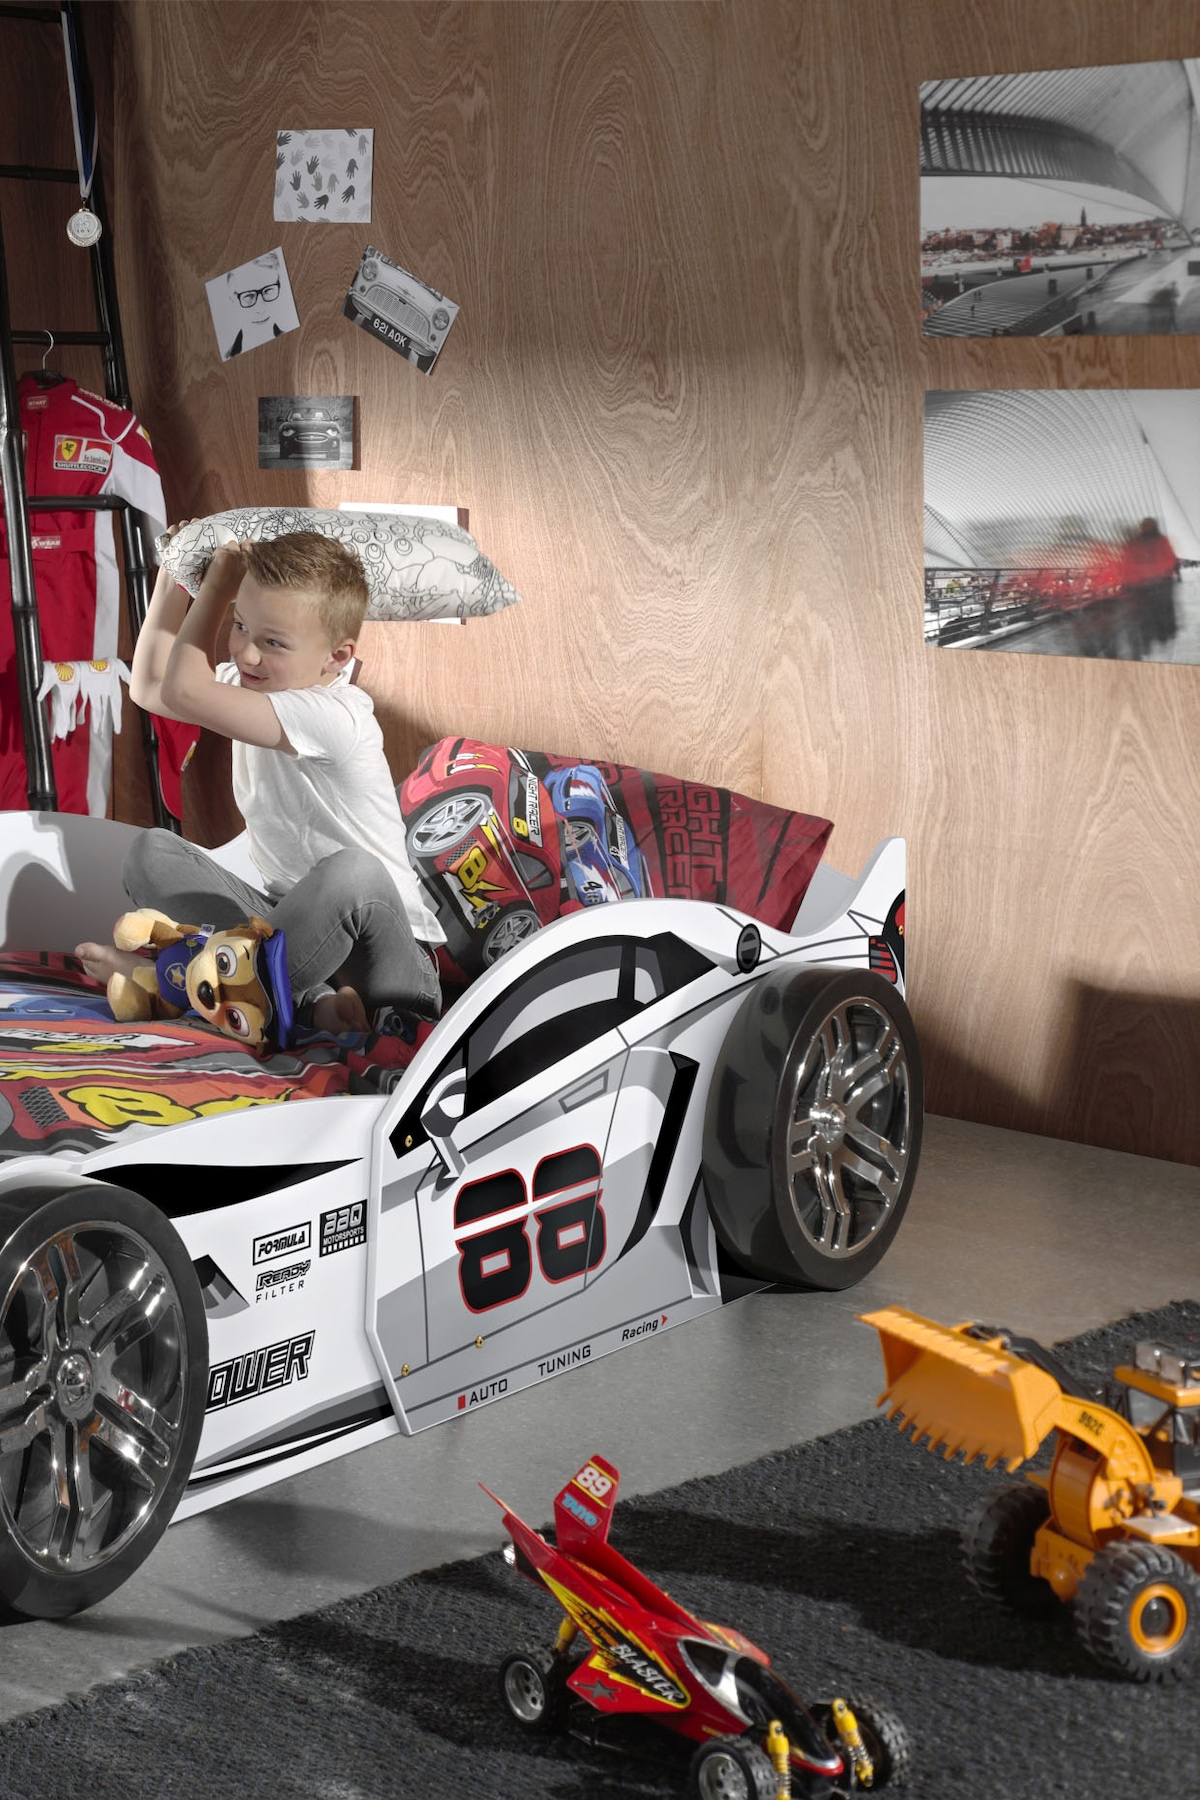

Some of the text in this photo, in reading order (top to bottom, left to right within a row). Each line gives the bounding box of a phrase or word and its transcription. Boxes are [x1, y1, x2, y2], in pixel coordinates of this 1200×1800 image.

[388, 328, 407, 347] AOK
[529, 803, 540, 836] RACER
[258, 1230, 306, 1258] FORMULA
[323, 1225, 365, 1247] MOTORSPORTS
[453, 1142, 608, 1315] 88
[255, 1279, 305, 1304] FILTER
[469, 1318, 659, 1405] AUTO TUNING Racing
[576, 1466, 613, 1498] 89
[611, 1643, 685, 1701] BLASTER
